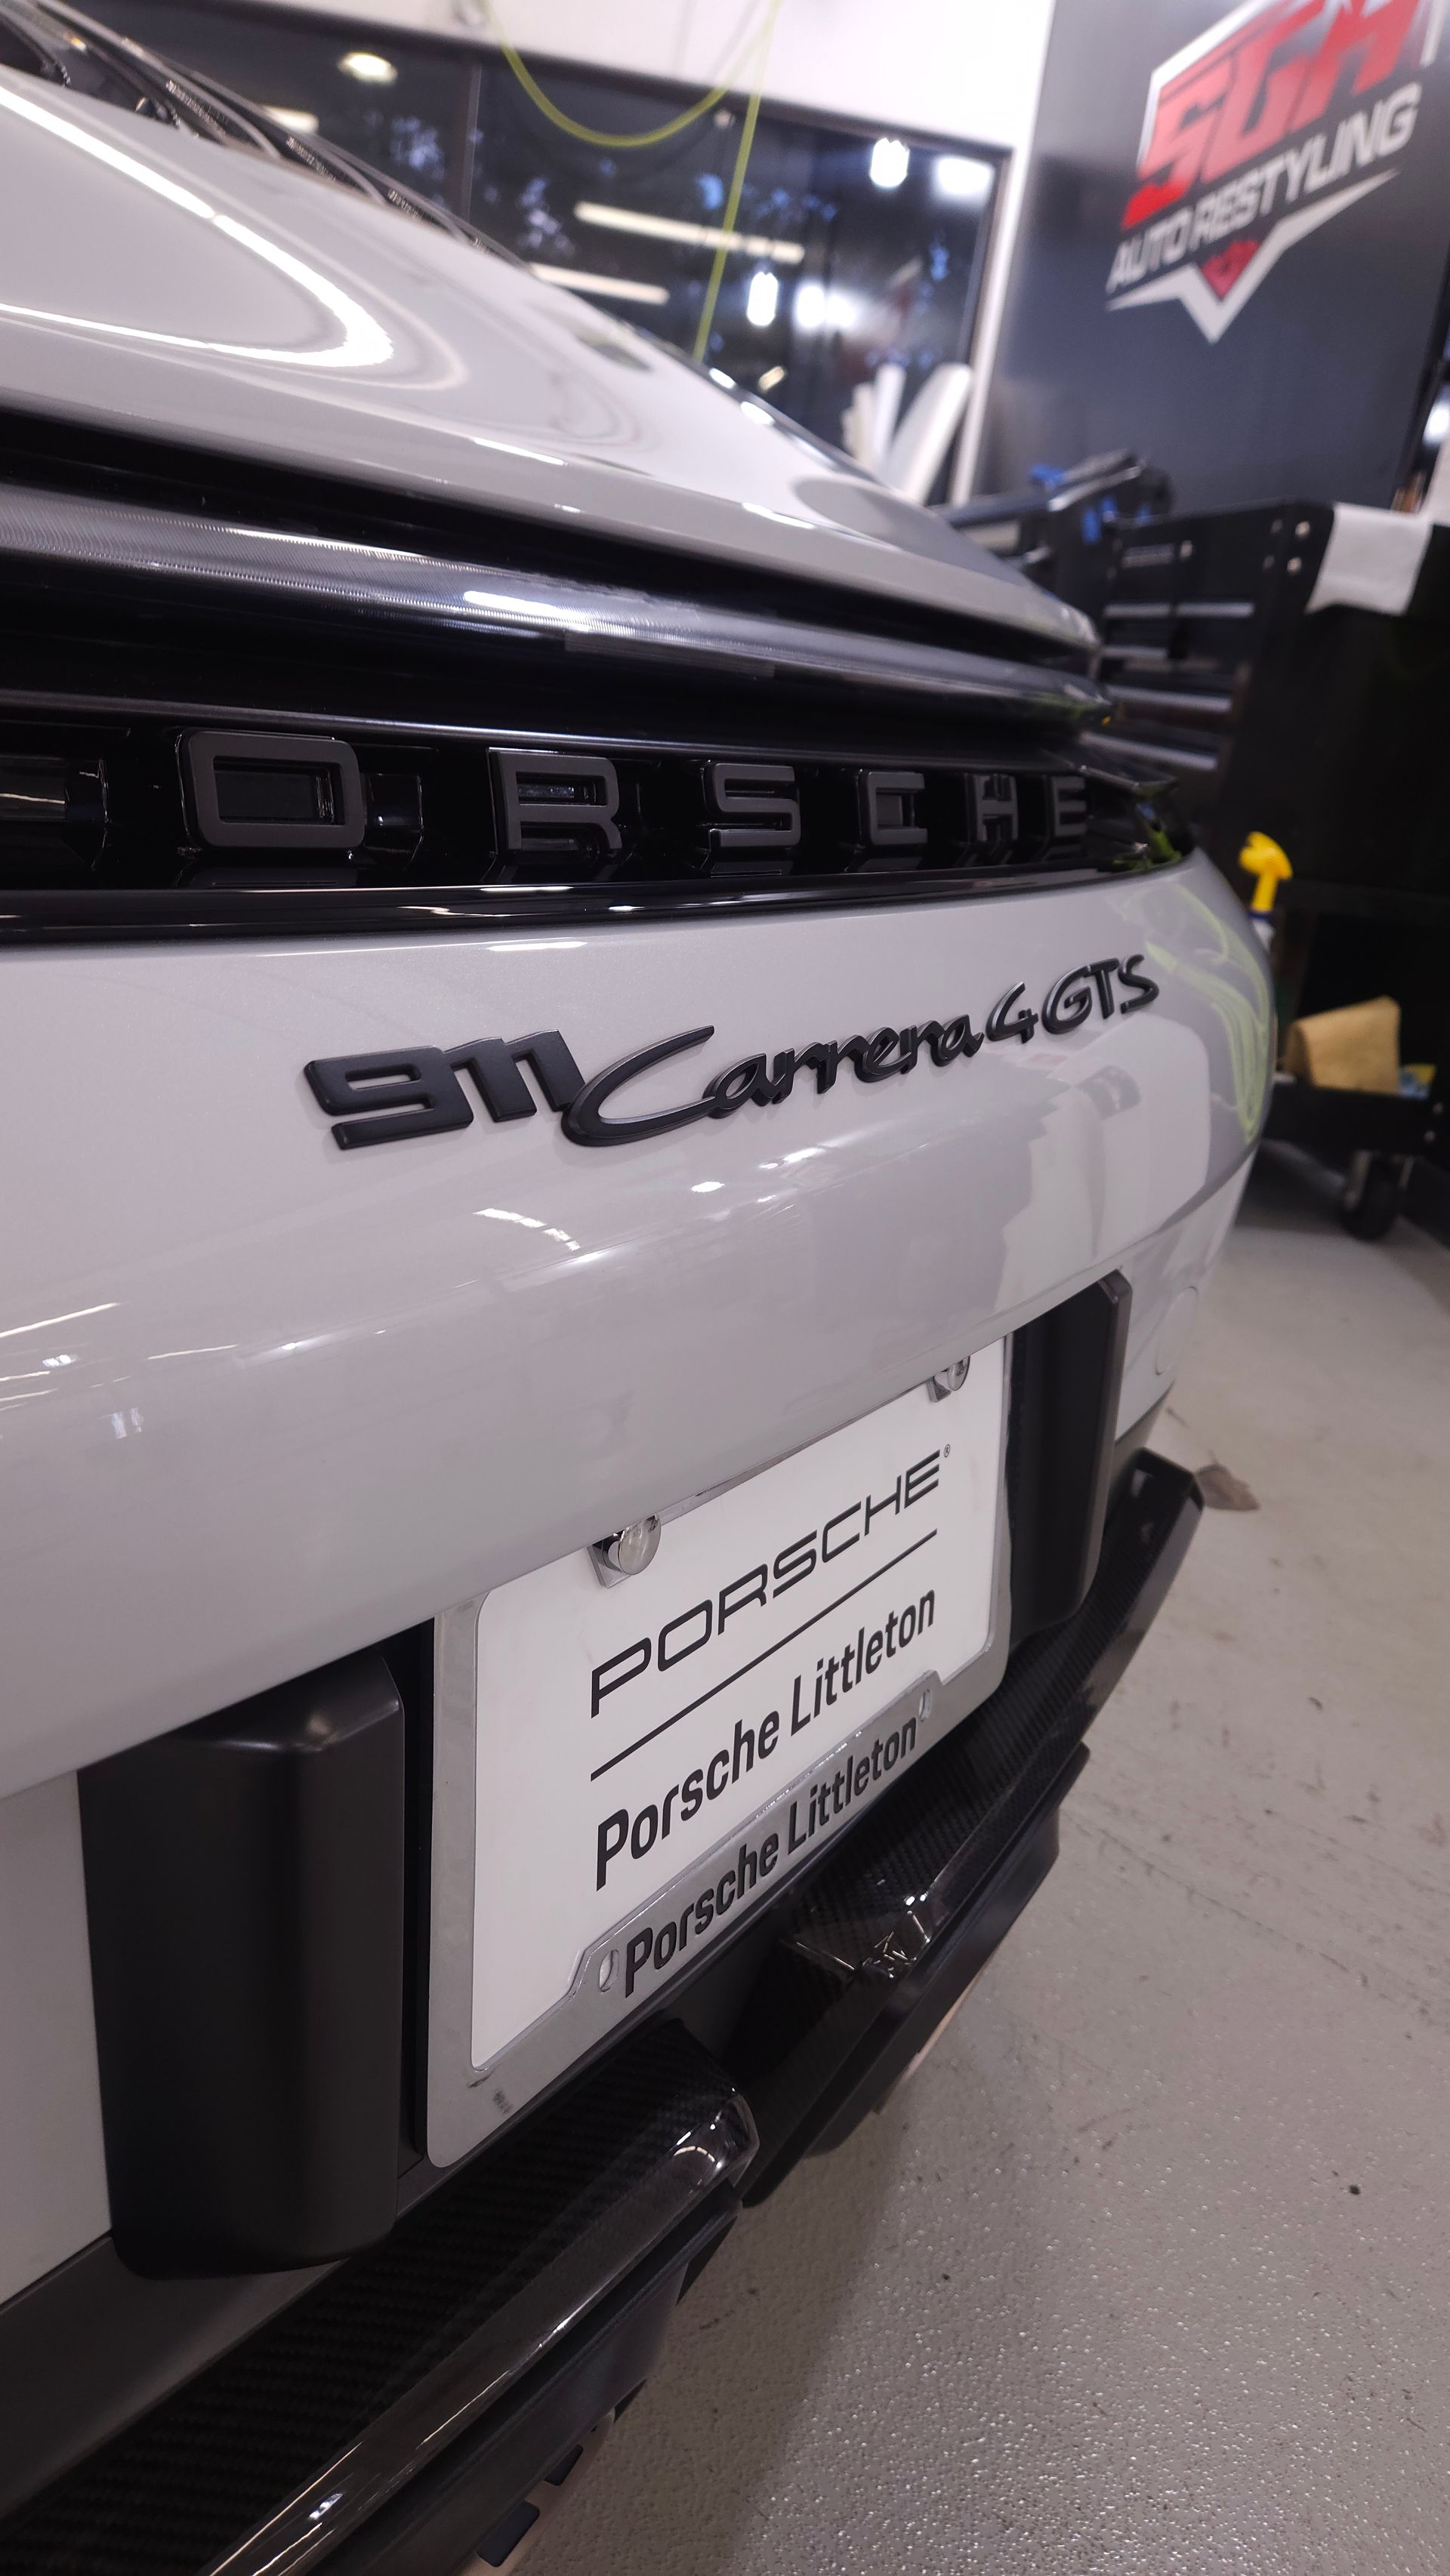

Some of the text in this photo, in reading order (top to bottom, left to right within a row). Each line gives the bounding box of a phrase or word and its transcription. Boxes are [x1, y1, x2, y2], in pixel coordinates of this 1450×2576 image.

[1106, 81, 1423, 295] AUTO RESTYLING
[303, 953, 1161, 1151] 911 Carrera 4 GTS
[591, 1448, 941, 1719] PORSCHE
[595, 1588, 936, 1892] Porsche Littleton
[624, 1715, 918, 1998] Porsche Littleton
